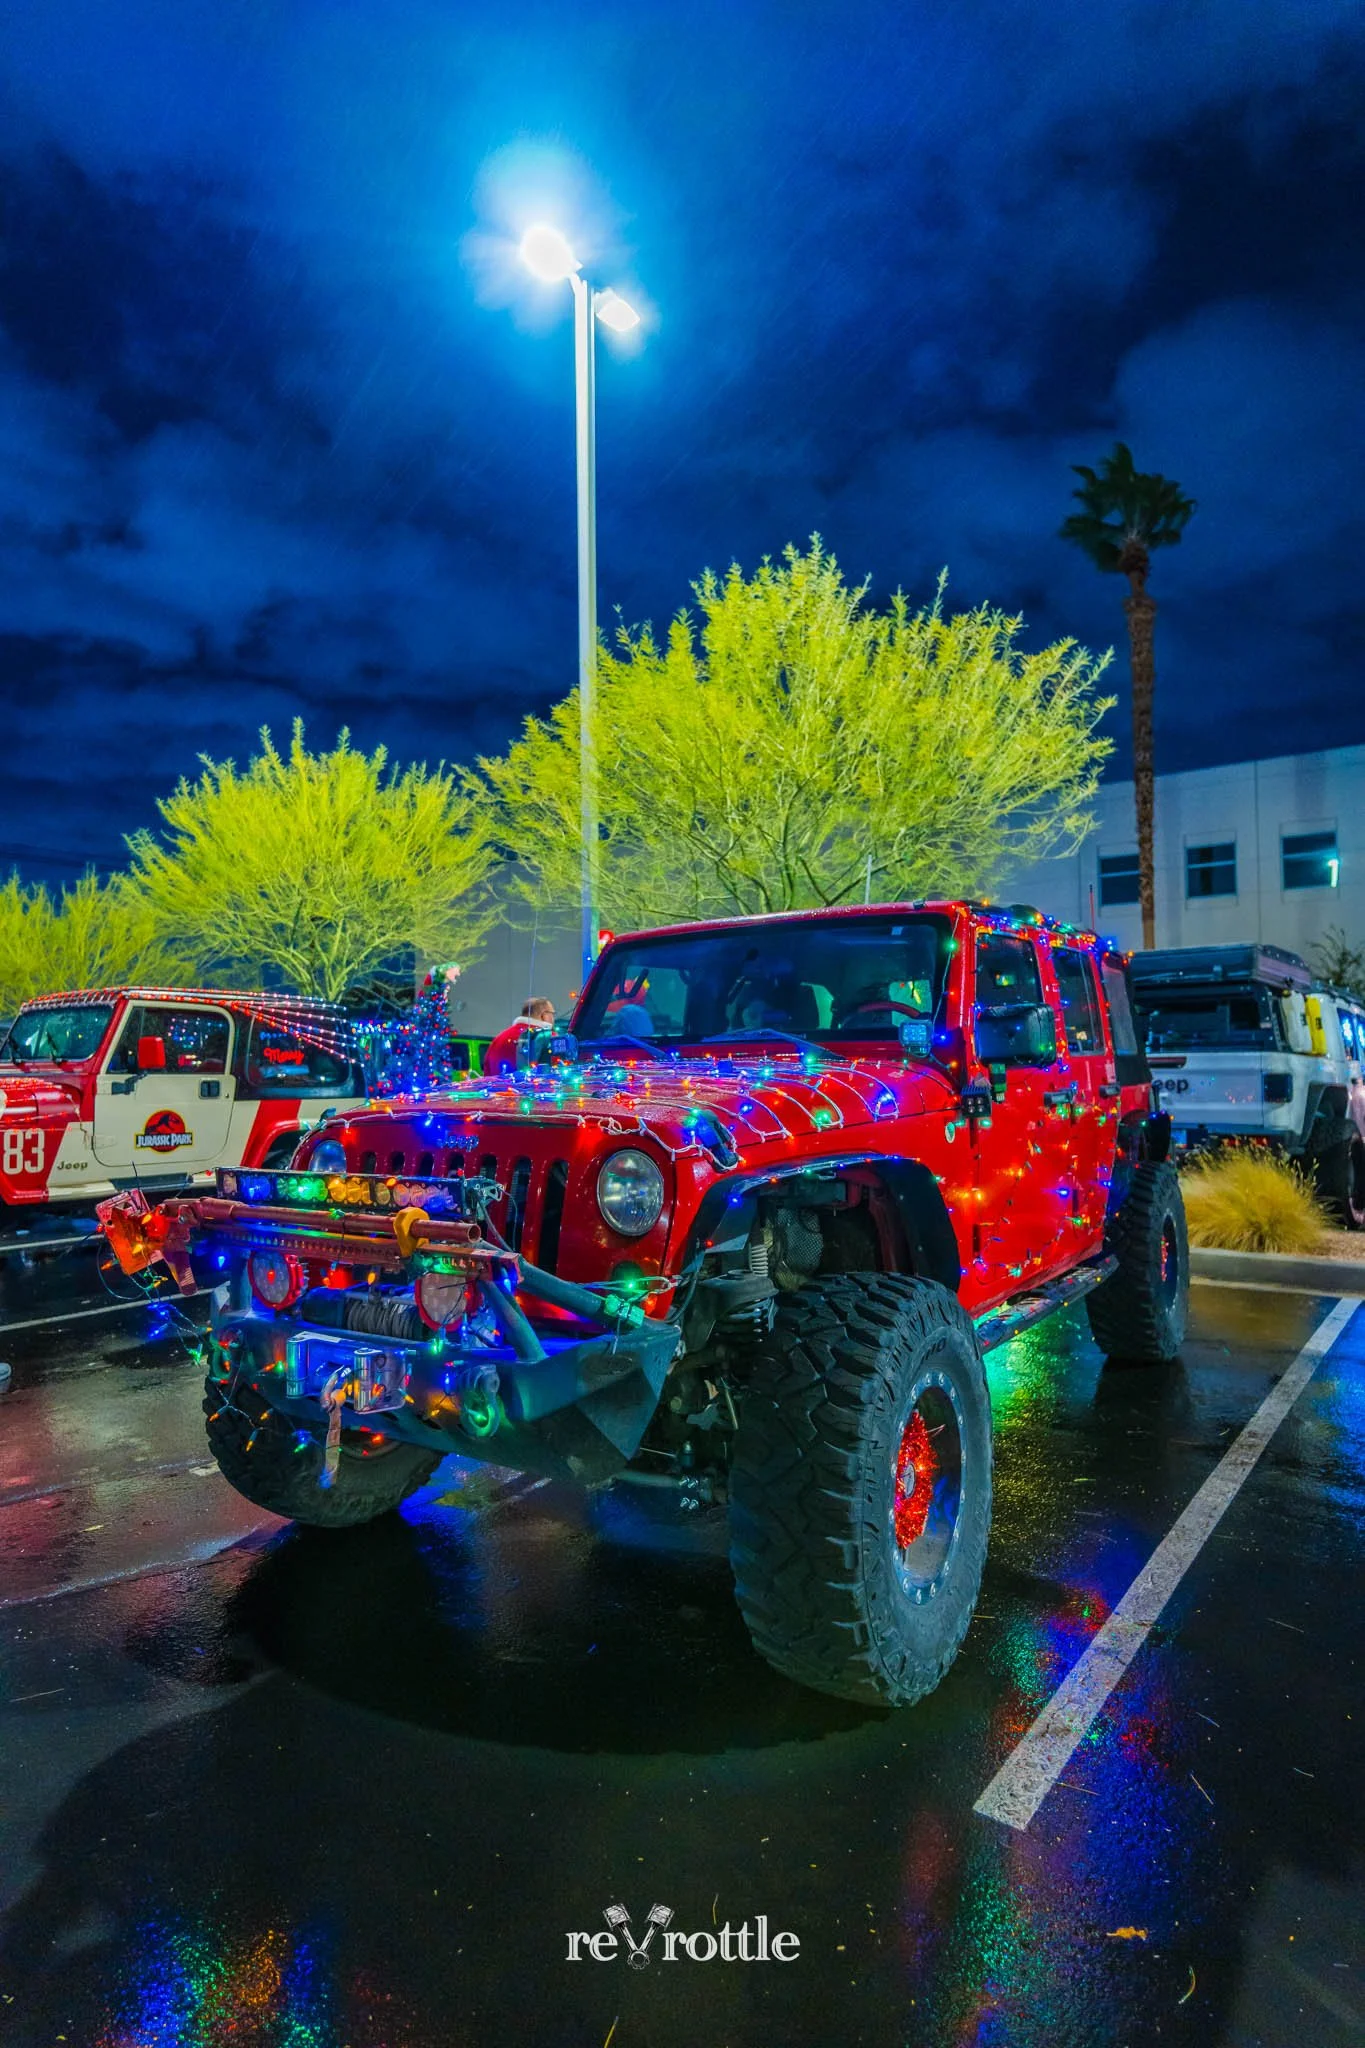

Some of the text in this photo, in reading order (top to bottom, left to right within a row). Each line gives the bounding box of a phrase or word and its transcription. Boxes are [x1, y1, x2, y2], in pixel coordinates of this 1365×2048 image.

[263, 1047, 304, 1065] Merry
[1151, 1079, 1189, 1094] eep
[137, 1133, 193, 1148] JURASSIC PARK
[436, 1129, 479, 1152] Jeep
[3, 1128, 45, 1175] 83
[57, 1160, 88, 1171] Jeep
